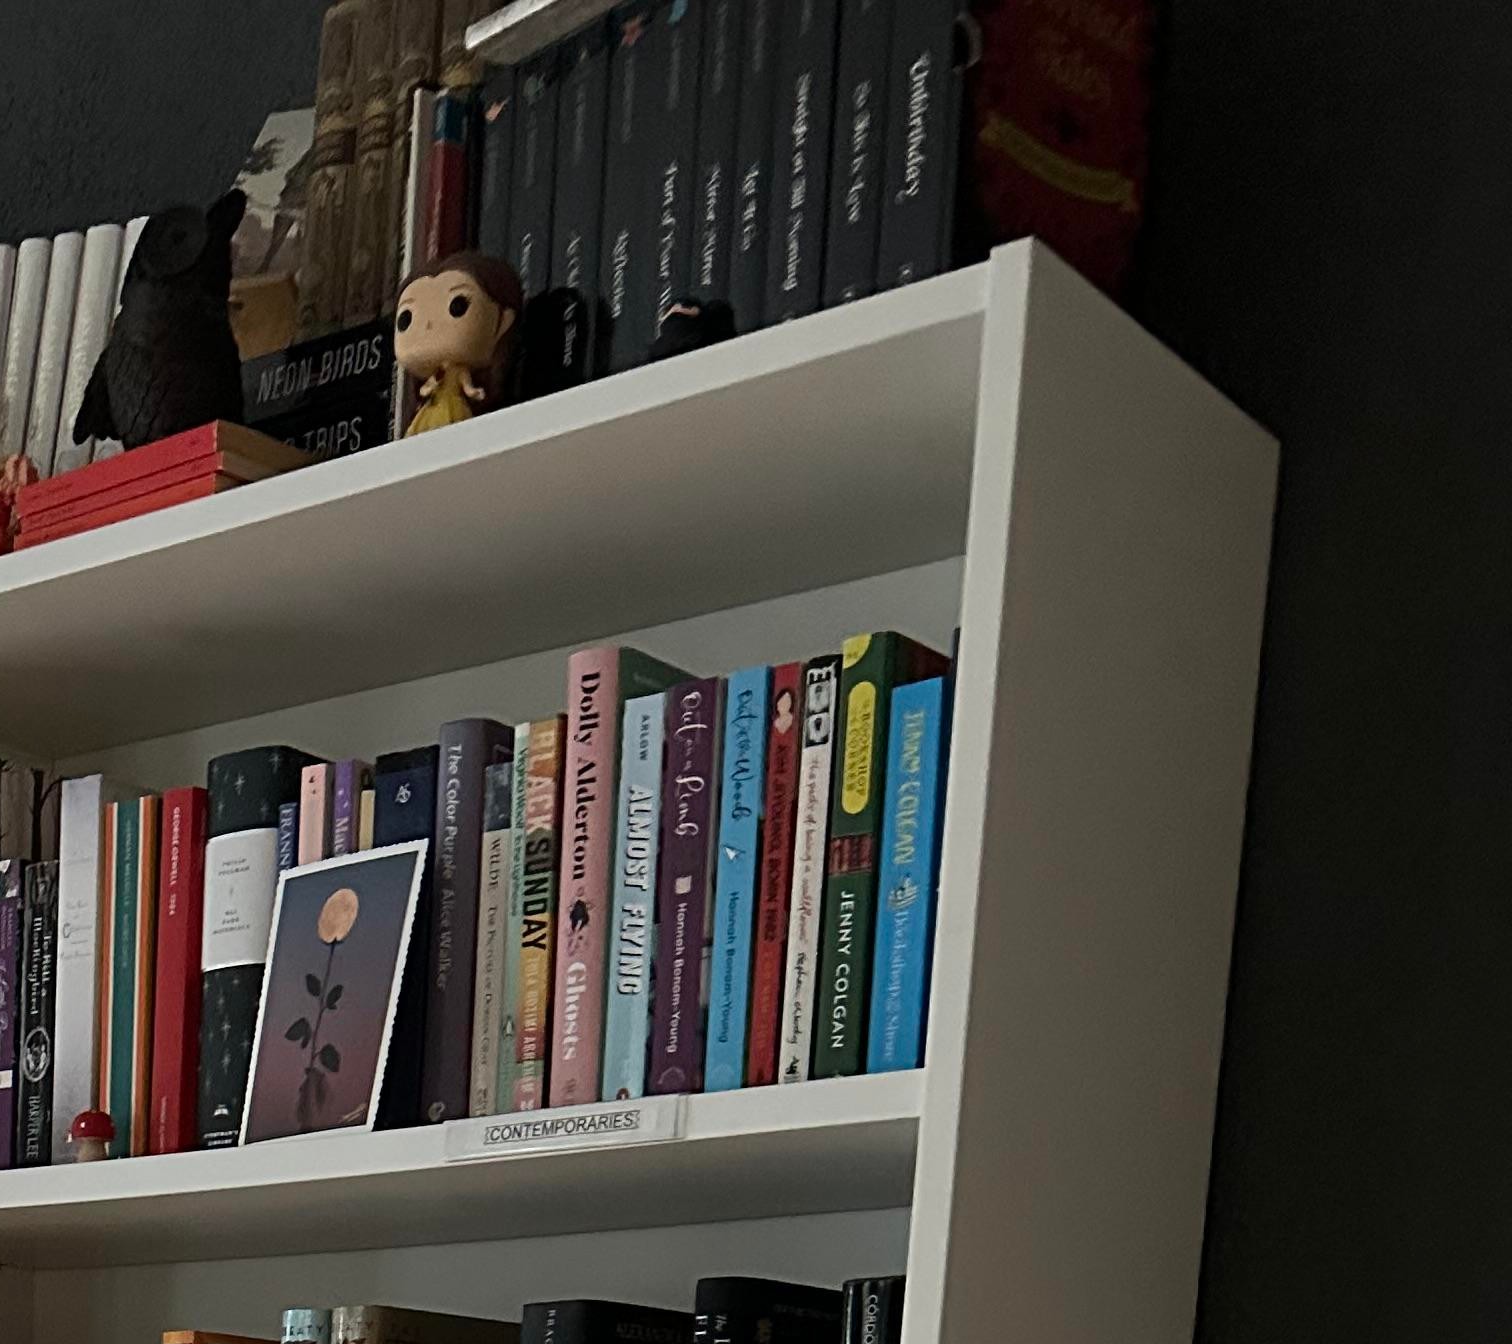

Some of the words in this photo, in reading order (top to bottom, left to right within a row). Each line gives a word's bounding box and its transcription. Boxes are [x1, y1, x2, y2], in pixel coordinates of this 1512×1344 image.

[257, 357, 312, 405] NEON
[315, 334, 384, 387] BIRDS
[571, 670, 601, 747] Dolly
[446, 743, 463, 775] The
[523, 726, 558, 834] BLACK
[442, 778, 460, 821] Color
[569, 755, 597, 881] Alderton
[438, 824, 459, 881] Purple
[622, 783, 656, 891] ALMOST
[437, 888, 455, 927] Alice
[519, 837, 552, 951] SUNDAY
[836, 889, 857, 955] JENNY
[434, 931, 453, 992] Walker
[615, 903, 650, 997] FLYING
[671, 902, 689, 955] Hannah
[560, 961, 588, 1061] Ghosts
[665, 958, 684, 1054] Bonam-Young
[828, 963, 853, 1049] COLGAN
[23, 1136, 39, 1159] LEE
[24, 1095, 42, 1135] HARPER
[490, 1111, 635, 1143] CONTEMPORARIES
